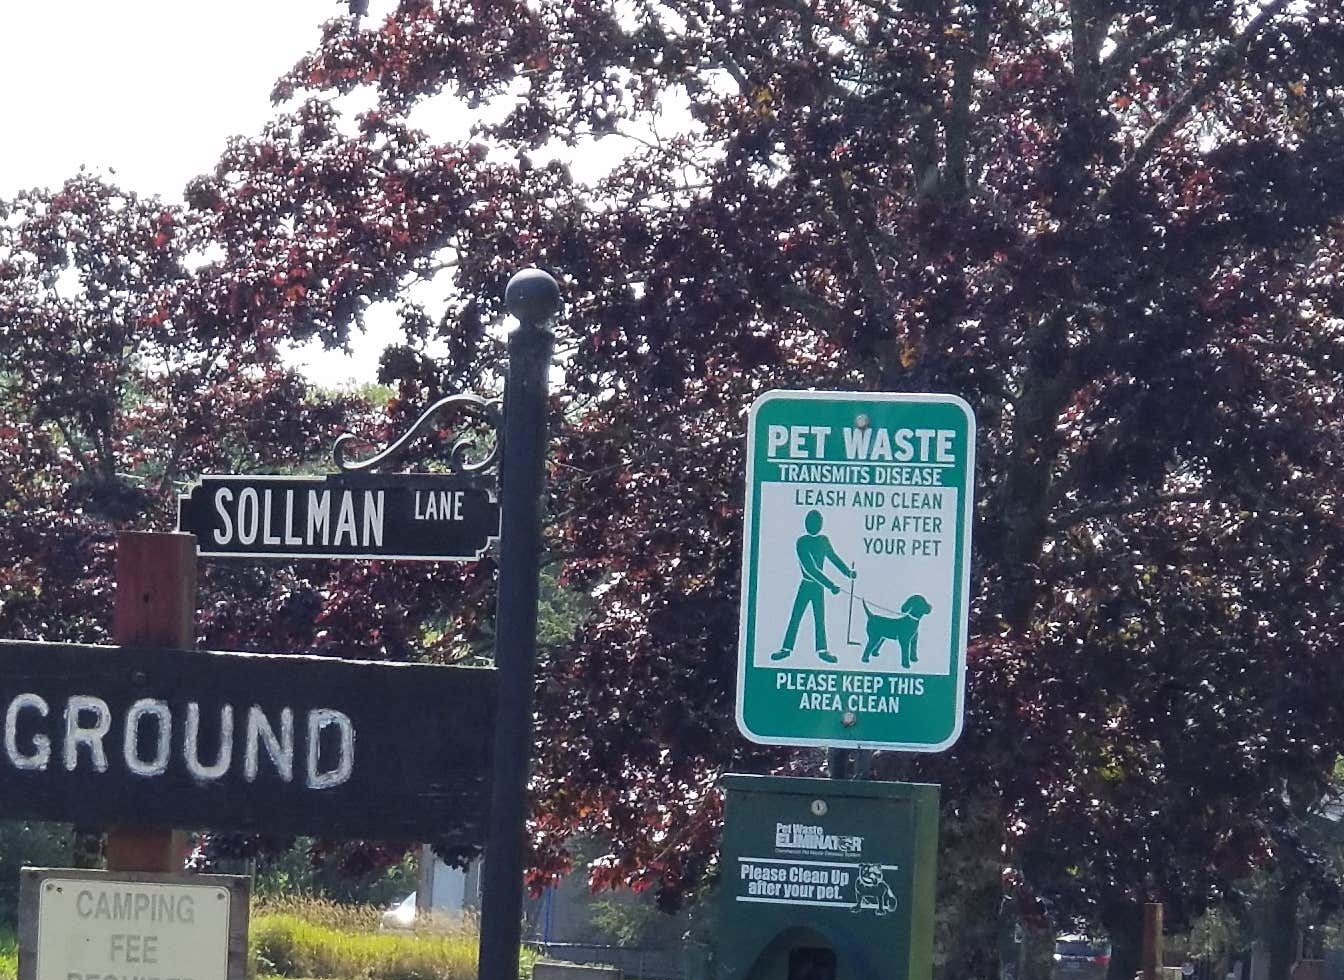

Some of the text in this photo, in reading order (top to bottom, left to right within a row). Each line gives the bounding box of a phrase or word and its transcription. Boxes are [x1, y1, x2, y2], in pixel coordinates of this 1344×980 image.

[767, 424, 956, 463] PET WASTE
[778, 464, 943, 486] TRANSMITS DISEASE
[795, 489, 943, 510] LEASH AND CLEAN
[213, 486, 465, 547] SOLLMAN LANE
[864, 515, 942, 533] UP AFTER
[863, 537, 942, 557] YOUR PET
[776, 672, 924, 696] PLEASE KEEP THIS
[799, 693, 899, 714] AREA CLEAN
[776, 822, 823, 835] Pet Waste
[741, 864, 849, 886] Please Clean Up
[748, 880, 843, 900] after your pet.
[75, 890, 195, 925] CAMPING
[109, 934, 158, 964] FEE
